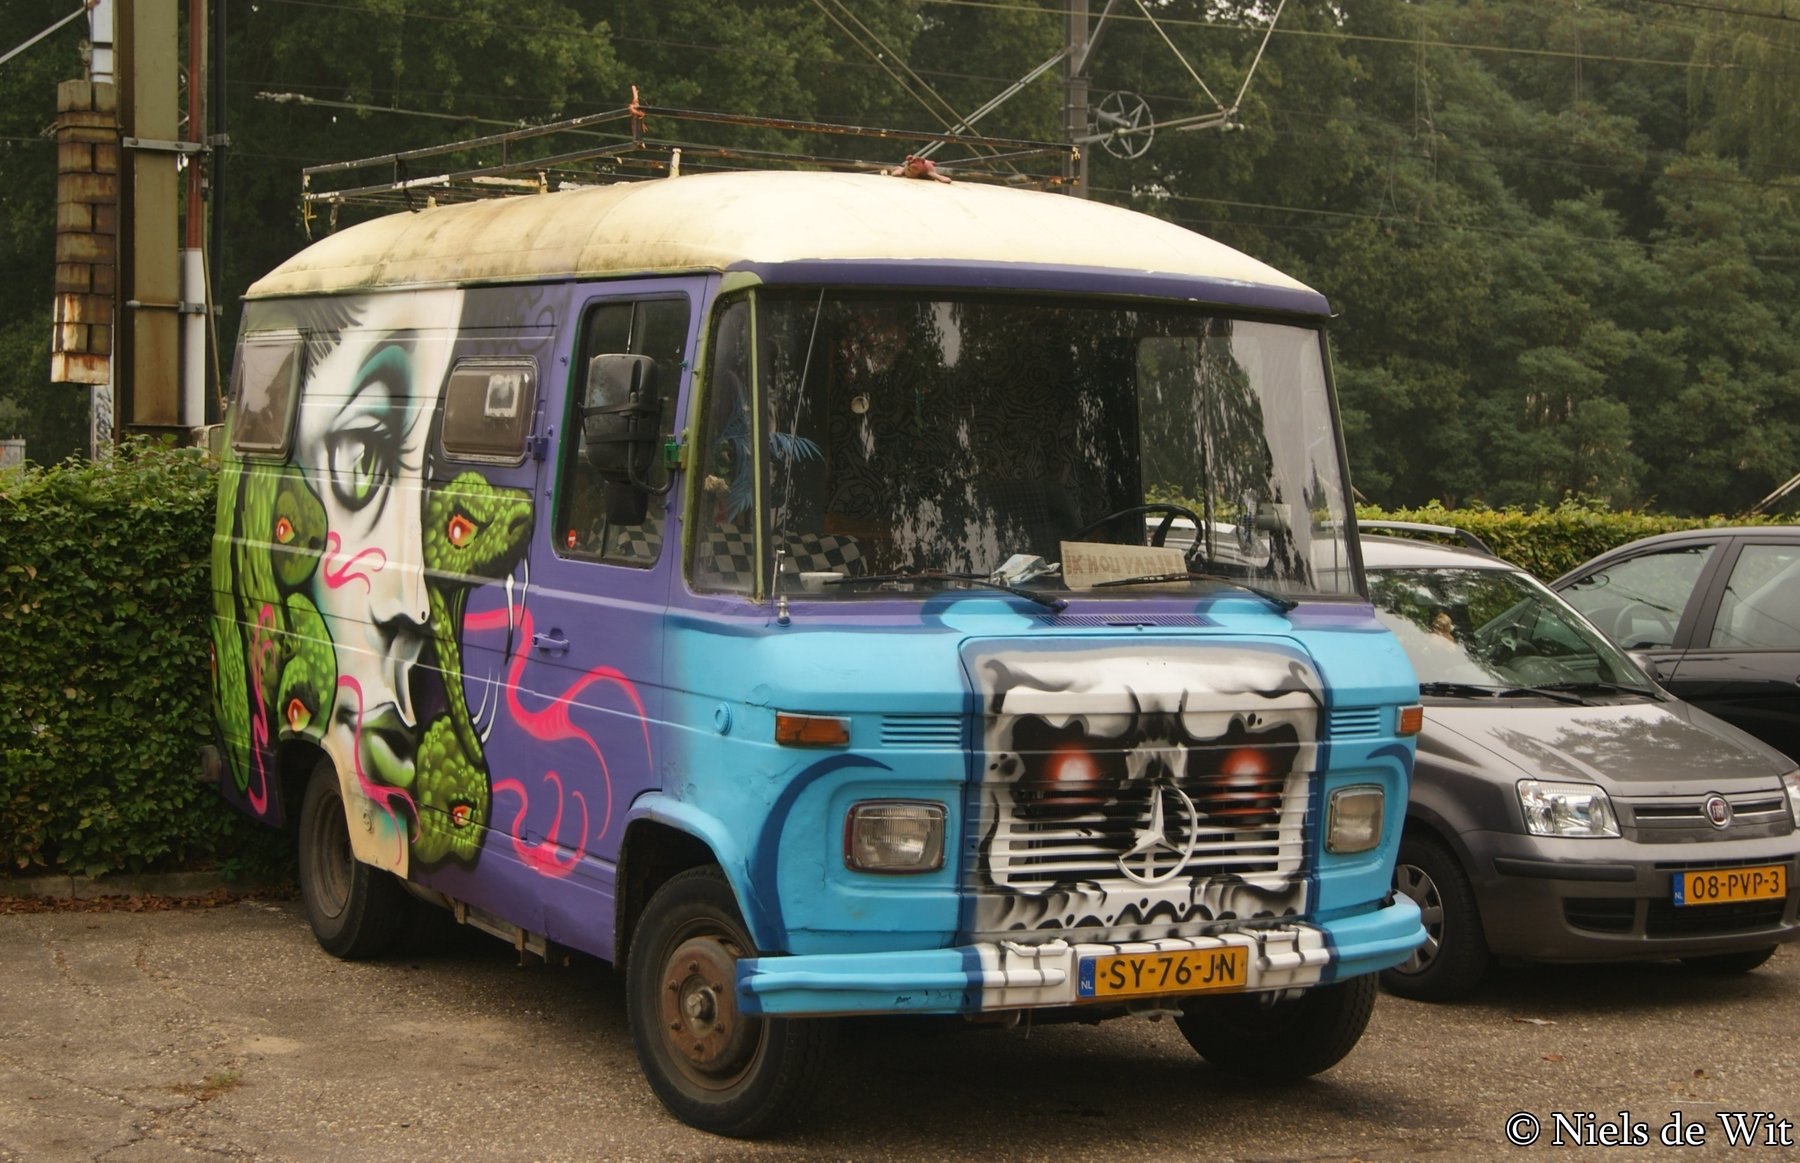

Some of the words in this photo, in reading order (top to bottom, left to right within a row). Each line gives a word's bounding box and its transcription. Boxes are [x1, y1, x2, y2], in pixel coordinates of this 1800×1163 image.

[1674, 891, 1683, 900] NL
[1692, 870, 1780, 900] 08-PVP-3
[1108, 952, 1236, 990] SY-76-JN
[1080, 978, 1094, 990] NL
